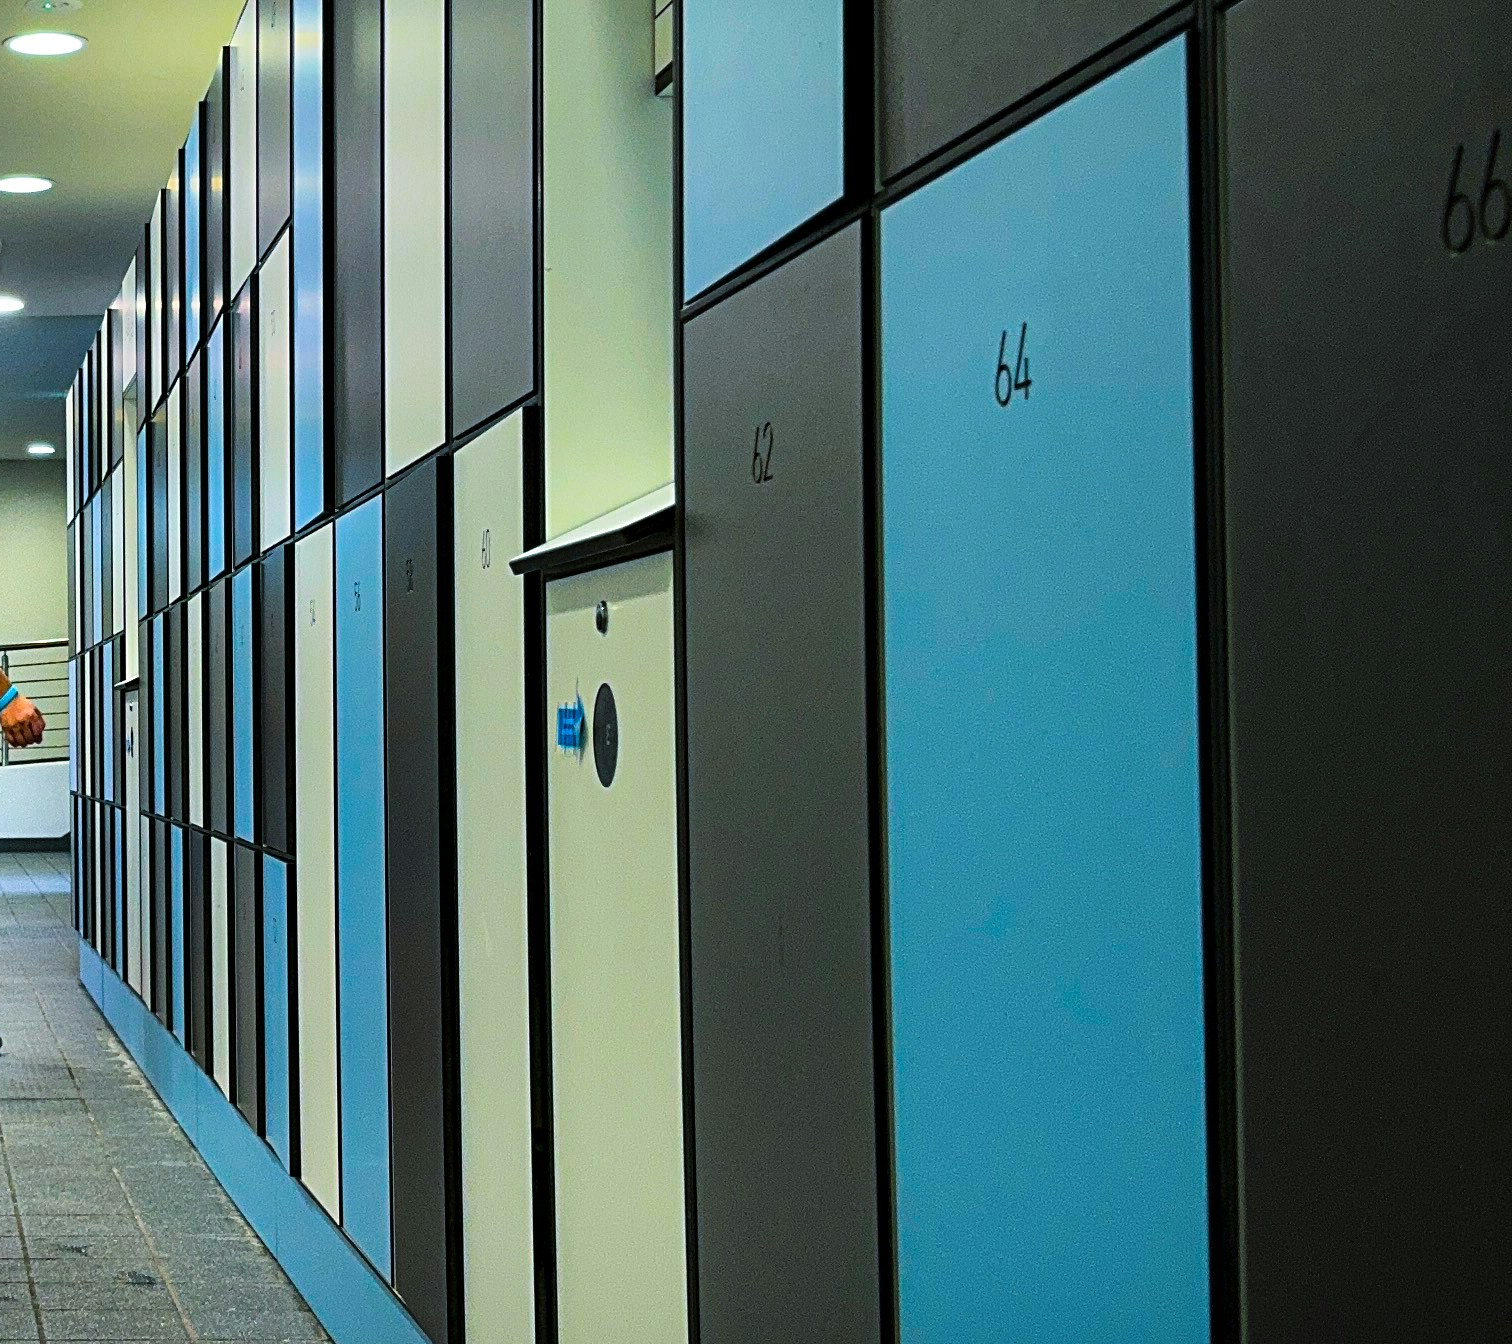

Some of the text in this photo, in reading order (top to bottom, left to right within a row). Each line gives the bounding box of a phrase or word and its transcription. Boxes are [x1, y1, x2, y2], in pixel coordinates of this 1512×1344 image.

[1442, 129, 1512, 254] 66
[995, 321, 1032, 407] 64
[752, 421, 774, 484] 62
[481, 528, 491, 569] 60
